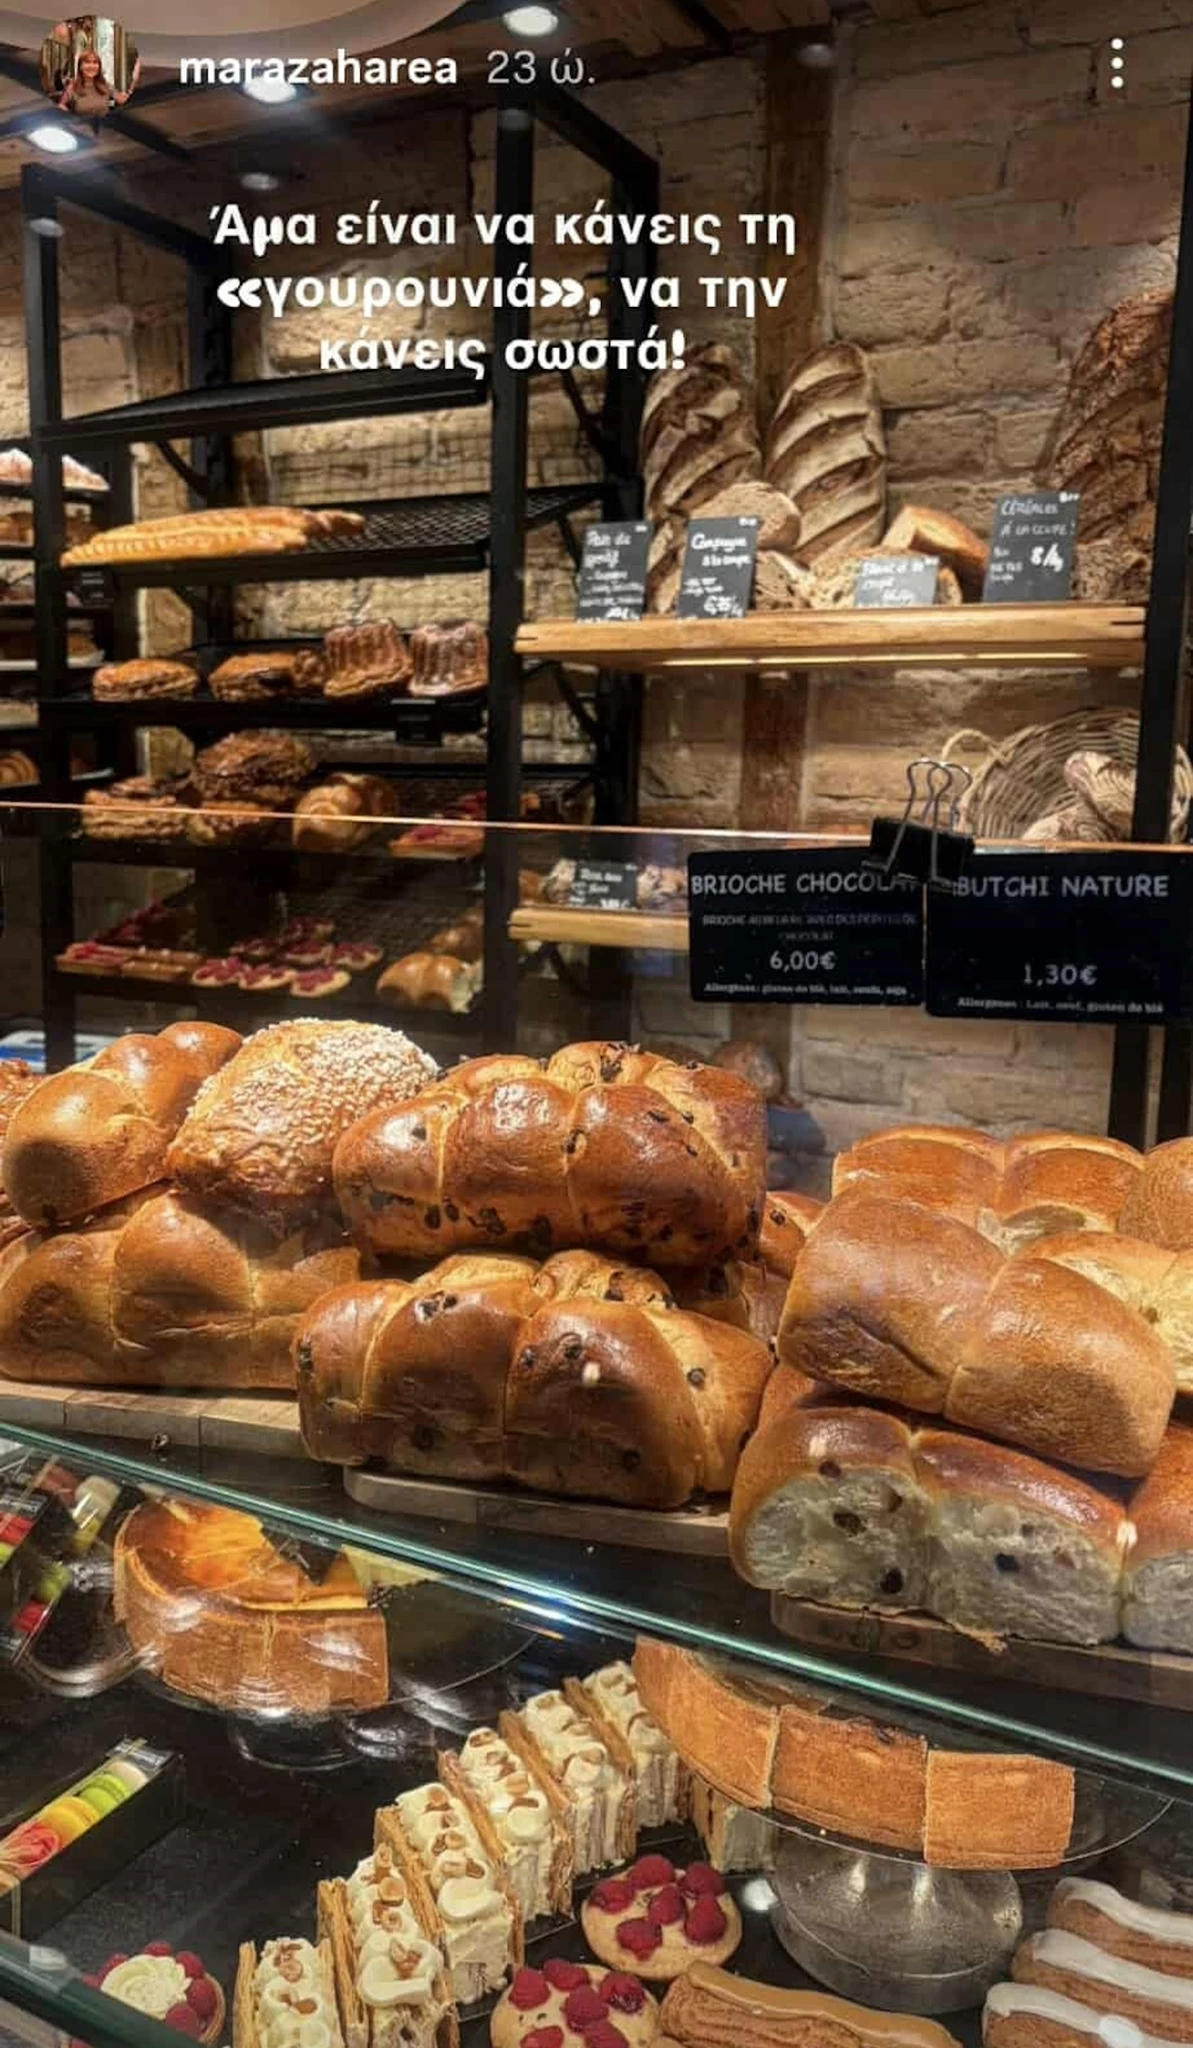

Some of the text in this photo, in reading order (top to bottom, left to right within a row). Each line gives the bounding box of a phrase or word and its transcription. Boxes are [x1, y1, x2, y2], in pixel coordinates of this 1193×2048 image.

[691, 873, 787, 896] BRIOCHE
[1061, 874, 1170, 898] NATURE
[769, 950, 837, 973] 6,00€
[1023, 963, 1098, 987] 1,30€
